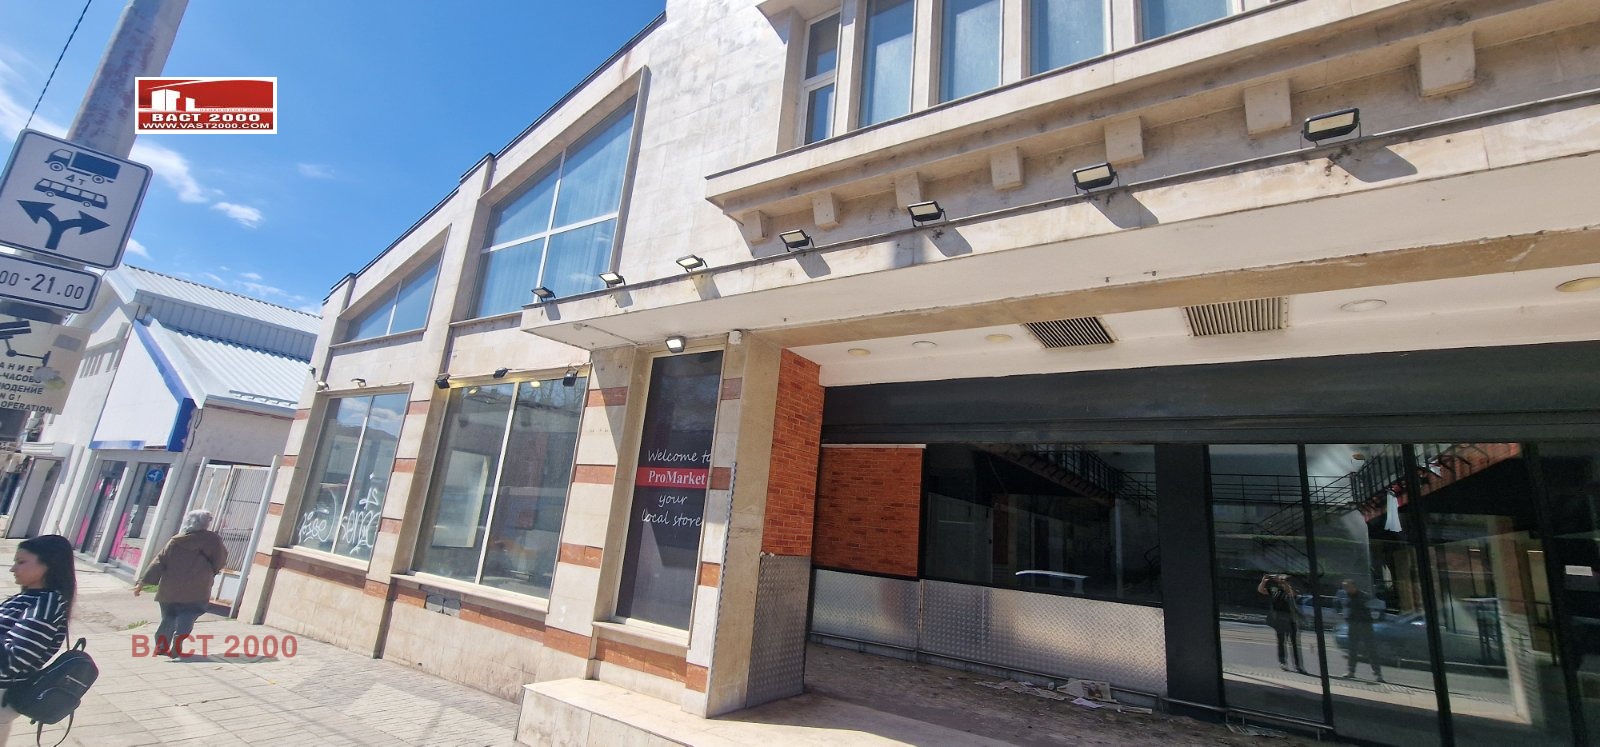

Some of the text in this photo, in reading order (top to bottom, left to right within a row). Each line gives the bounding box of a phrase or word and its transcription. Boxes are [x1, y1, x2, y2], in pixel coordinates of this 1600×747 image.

[1, 400, 53, 414] OPERATION
[648, 447, 699, 462] Welcome
[648, 470, 706, 485] ProMarket
[658, 494, 688, 508] your
[672, 512, 703, 527] store
